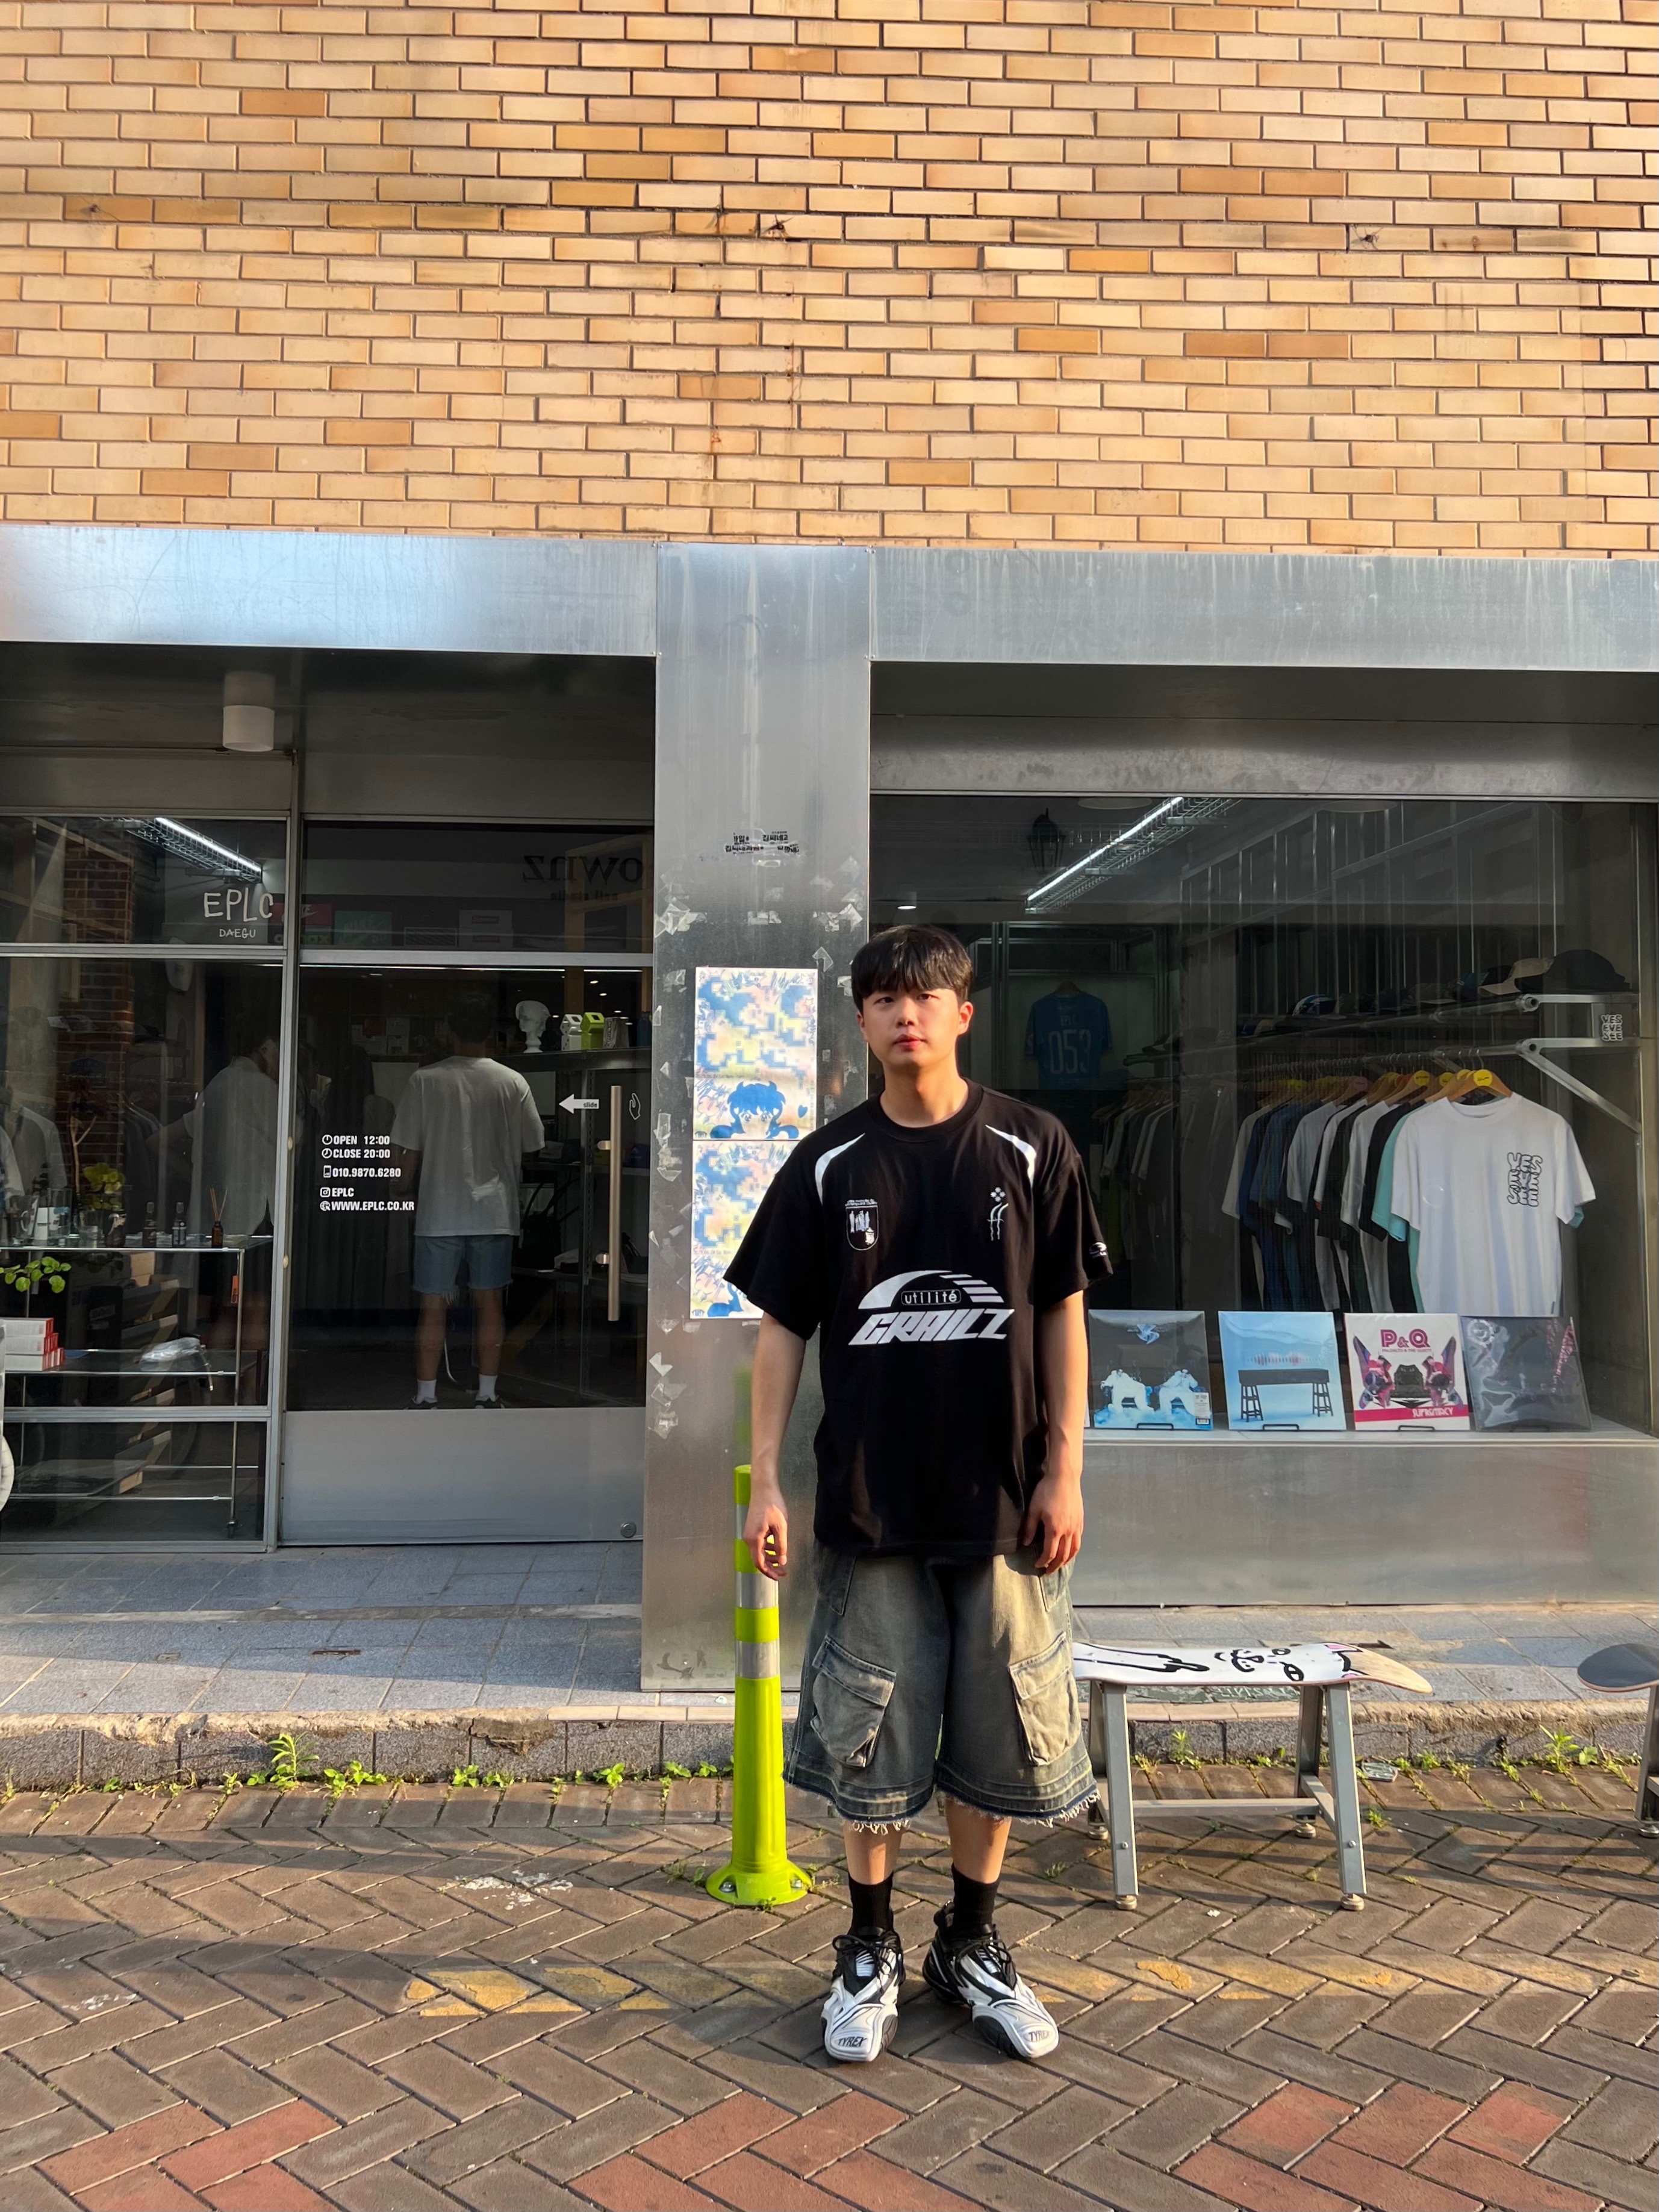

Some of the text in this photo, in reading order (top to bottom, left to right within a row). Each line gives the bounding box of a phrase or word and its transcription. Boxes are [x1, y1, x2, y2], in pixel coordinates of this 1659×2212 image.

[204, 887, 274, 922] EPLC
[219, 928, 256, 939] DAEGU
[1601, 1015, 1623, 1023] YES
[1602, 1032, 1623, 1041] SEE
[1048, 1029, 1091, 1074] 053
[333, 1135, 390, 1145] OPEN 12:00
[332, 1148, 391, 1159] CLOSE 20:00
[332, 1168, 402, 1177] 010.9870.6280
[332, 1188, 355, 1197] EPLC
[331, 1201, 414, 1211] WWW.EPLC.CO.KR
[904, 1290, 957, 1304] utilité
[848, 1308, 1015, 1346] GRAILZ
[838, 2036, 867, 2047] TYREX
